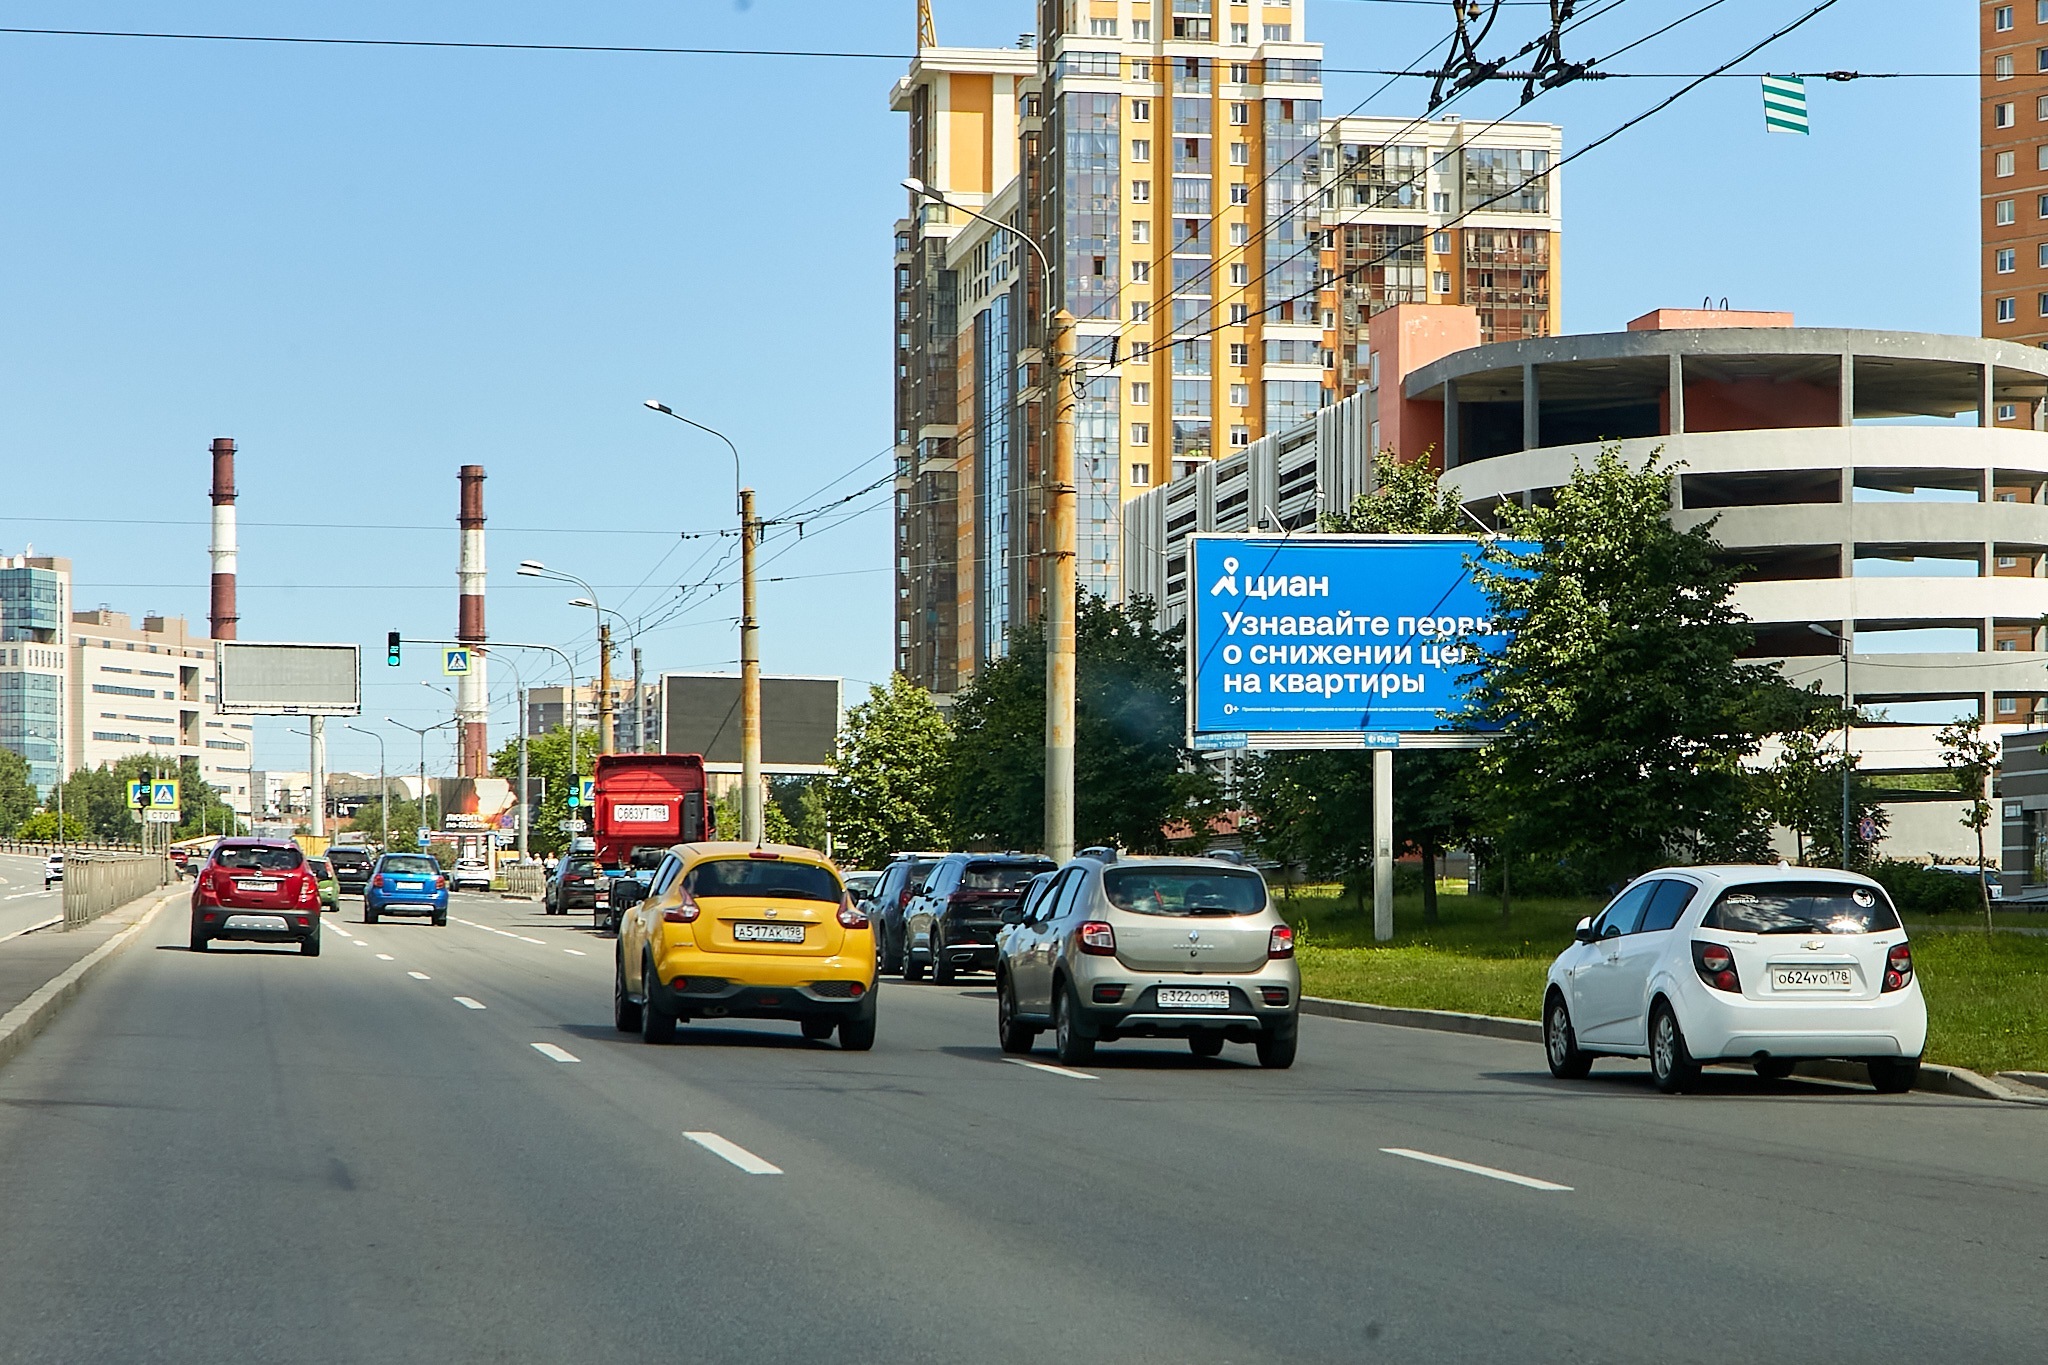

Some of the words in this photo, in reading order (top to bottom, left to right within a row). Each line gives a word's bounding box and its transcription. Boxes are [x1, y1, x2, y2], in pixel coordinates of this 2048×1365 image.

[1245, 575, 1329, 600] циан
[1221, 609, 1390, 636] Узнавайте
[1397, 615, 1507, 640] первы
[1222, 644, 1243, 665] о
[1249, 644, 1412, 665] снижении
[1223, 673, 1262, 693] на
[1269, 673, 1425, 699] квартиры
[1223, 703, 1240, 715] 0+
[1376, 734, 1398, 744] Russ
[151, 811, 176, 820] СТОП
[617, 807, 650, 820] С683УТ
[739, 925, 782, 938] А517АК
[784, 926, 801, 936] 198
[1778, 971, 1828, 984] О624УО
[1829, 970, 1848, 981] 178
[1161, 990, 1207, 1003] В322ОО
[1209, 990, 1226, 1000] 198
